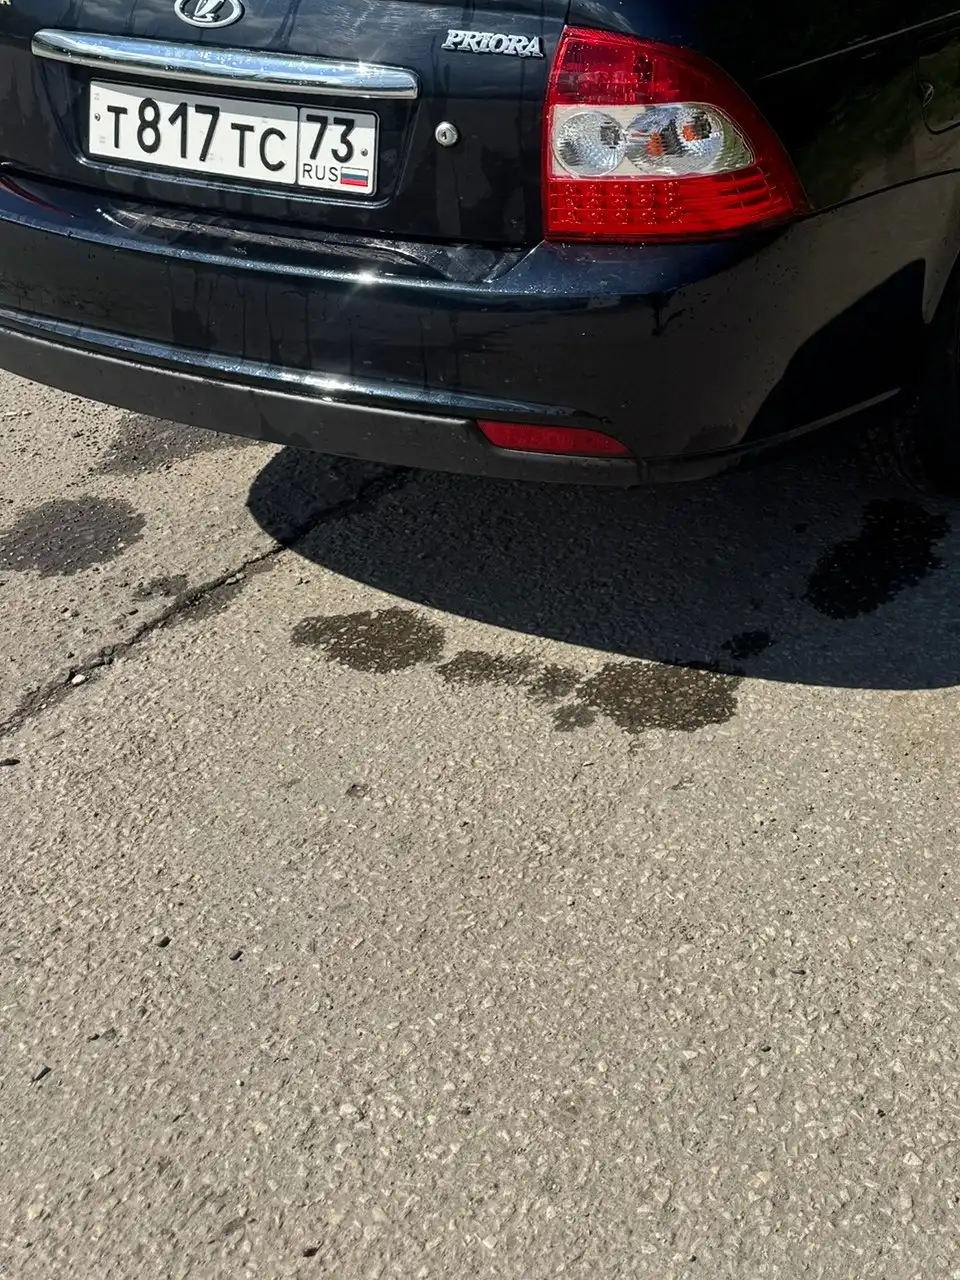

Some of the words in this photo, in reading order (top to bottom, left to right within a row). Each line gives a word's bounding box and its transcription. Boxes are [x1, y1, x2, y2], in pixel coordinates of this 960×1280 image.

[441, 29, 544, 58] PRIORA
[306, 114, 354, 163] 73
[303, 163, 338, 182] RUS
